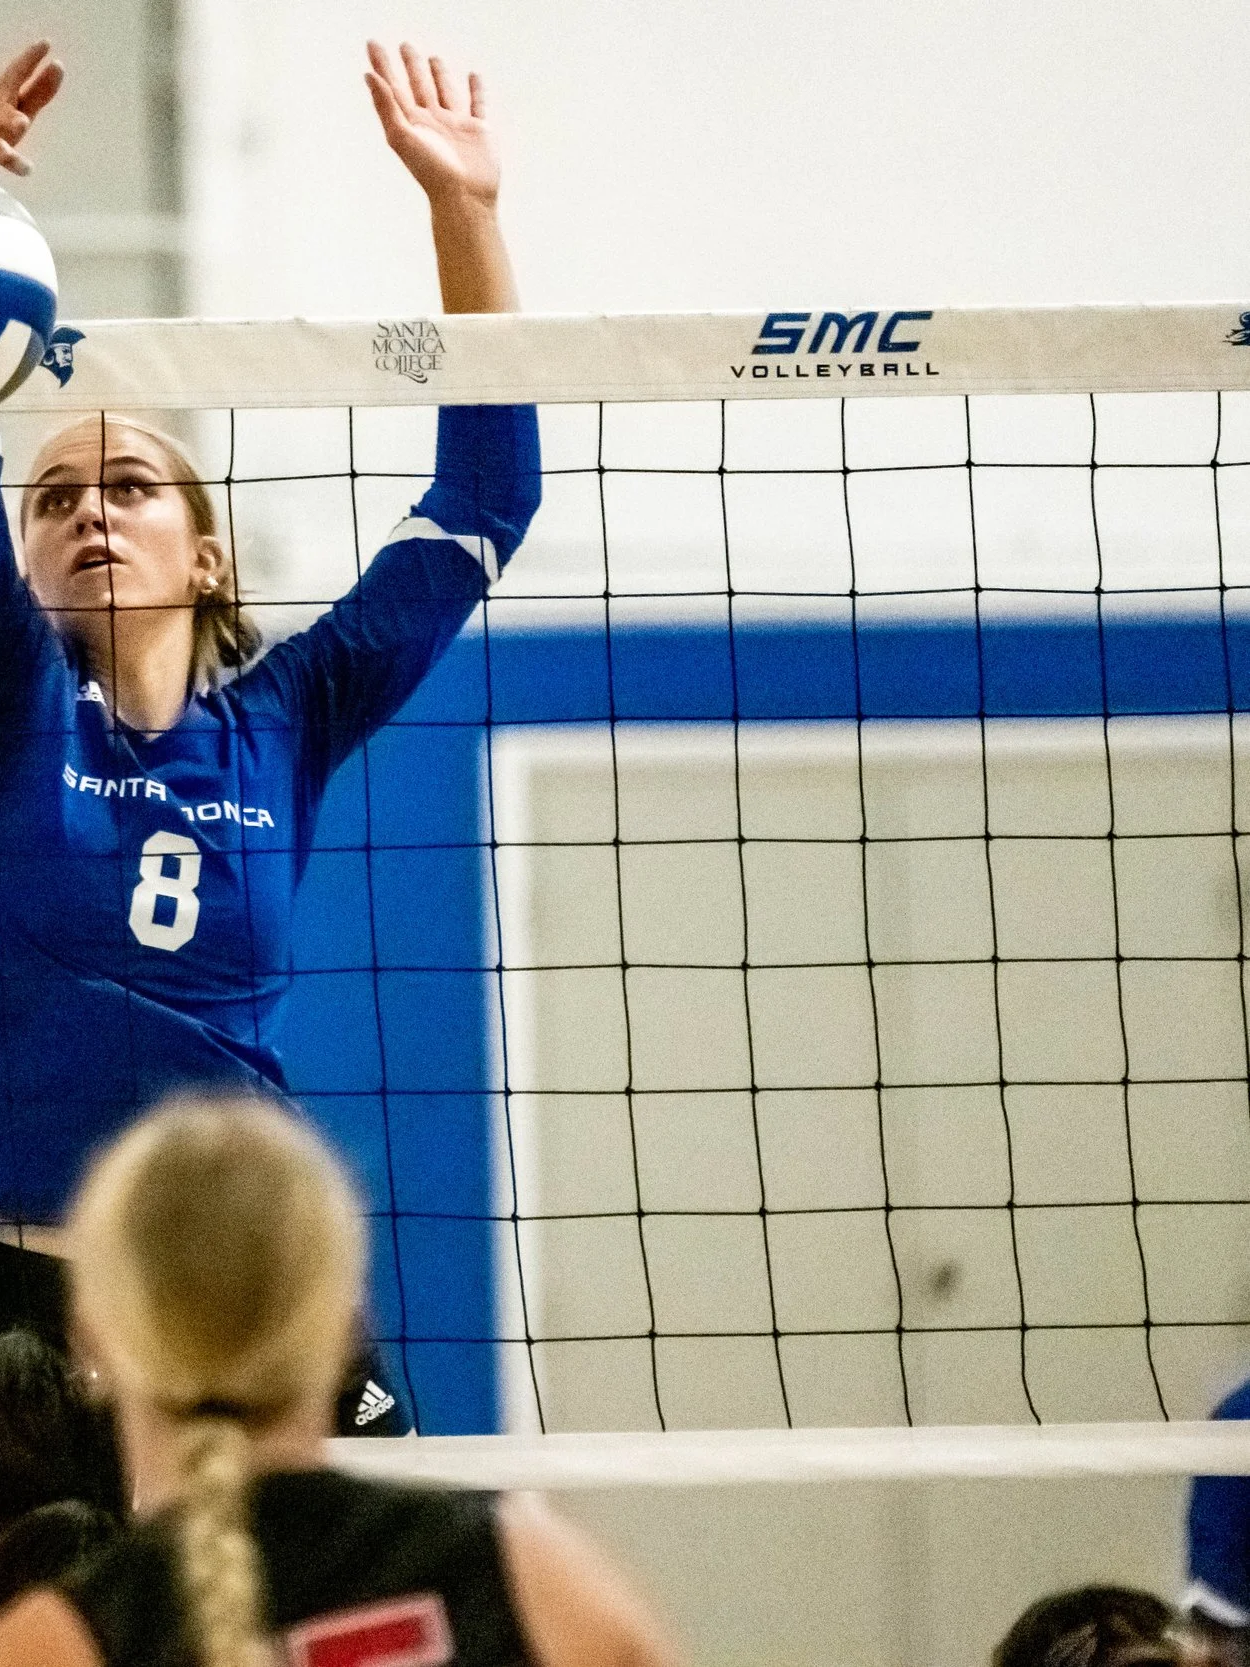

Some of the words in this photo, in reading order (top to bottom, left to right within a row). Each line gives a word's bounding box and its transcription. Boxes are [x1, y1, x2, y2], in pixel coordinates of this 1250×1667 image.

[376, 321, 440, 338] SANTA
[751, 310, 934, 355] SMC
[371, 338, 447, 354] MONICA
[375, 354, 443, 384] COLLEGE
[730, 362, 940, 379] VOLLEYBALL
[62, 762, 167, 801] SANTA
[181, 800, 276, 828] ONCA
[128, 830, 202, 952] 8
[354, 1394, 396, 1426] adidas
